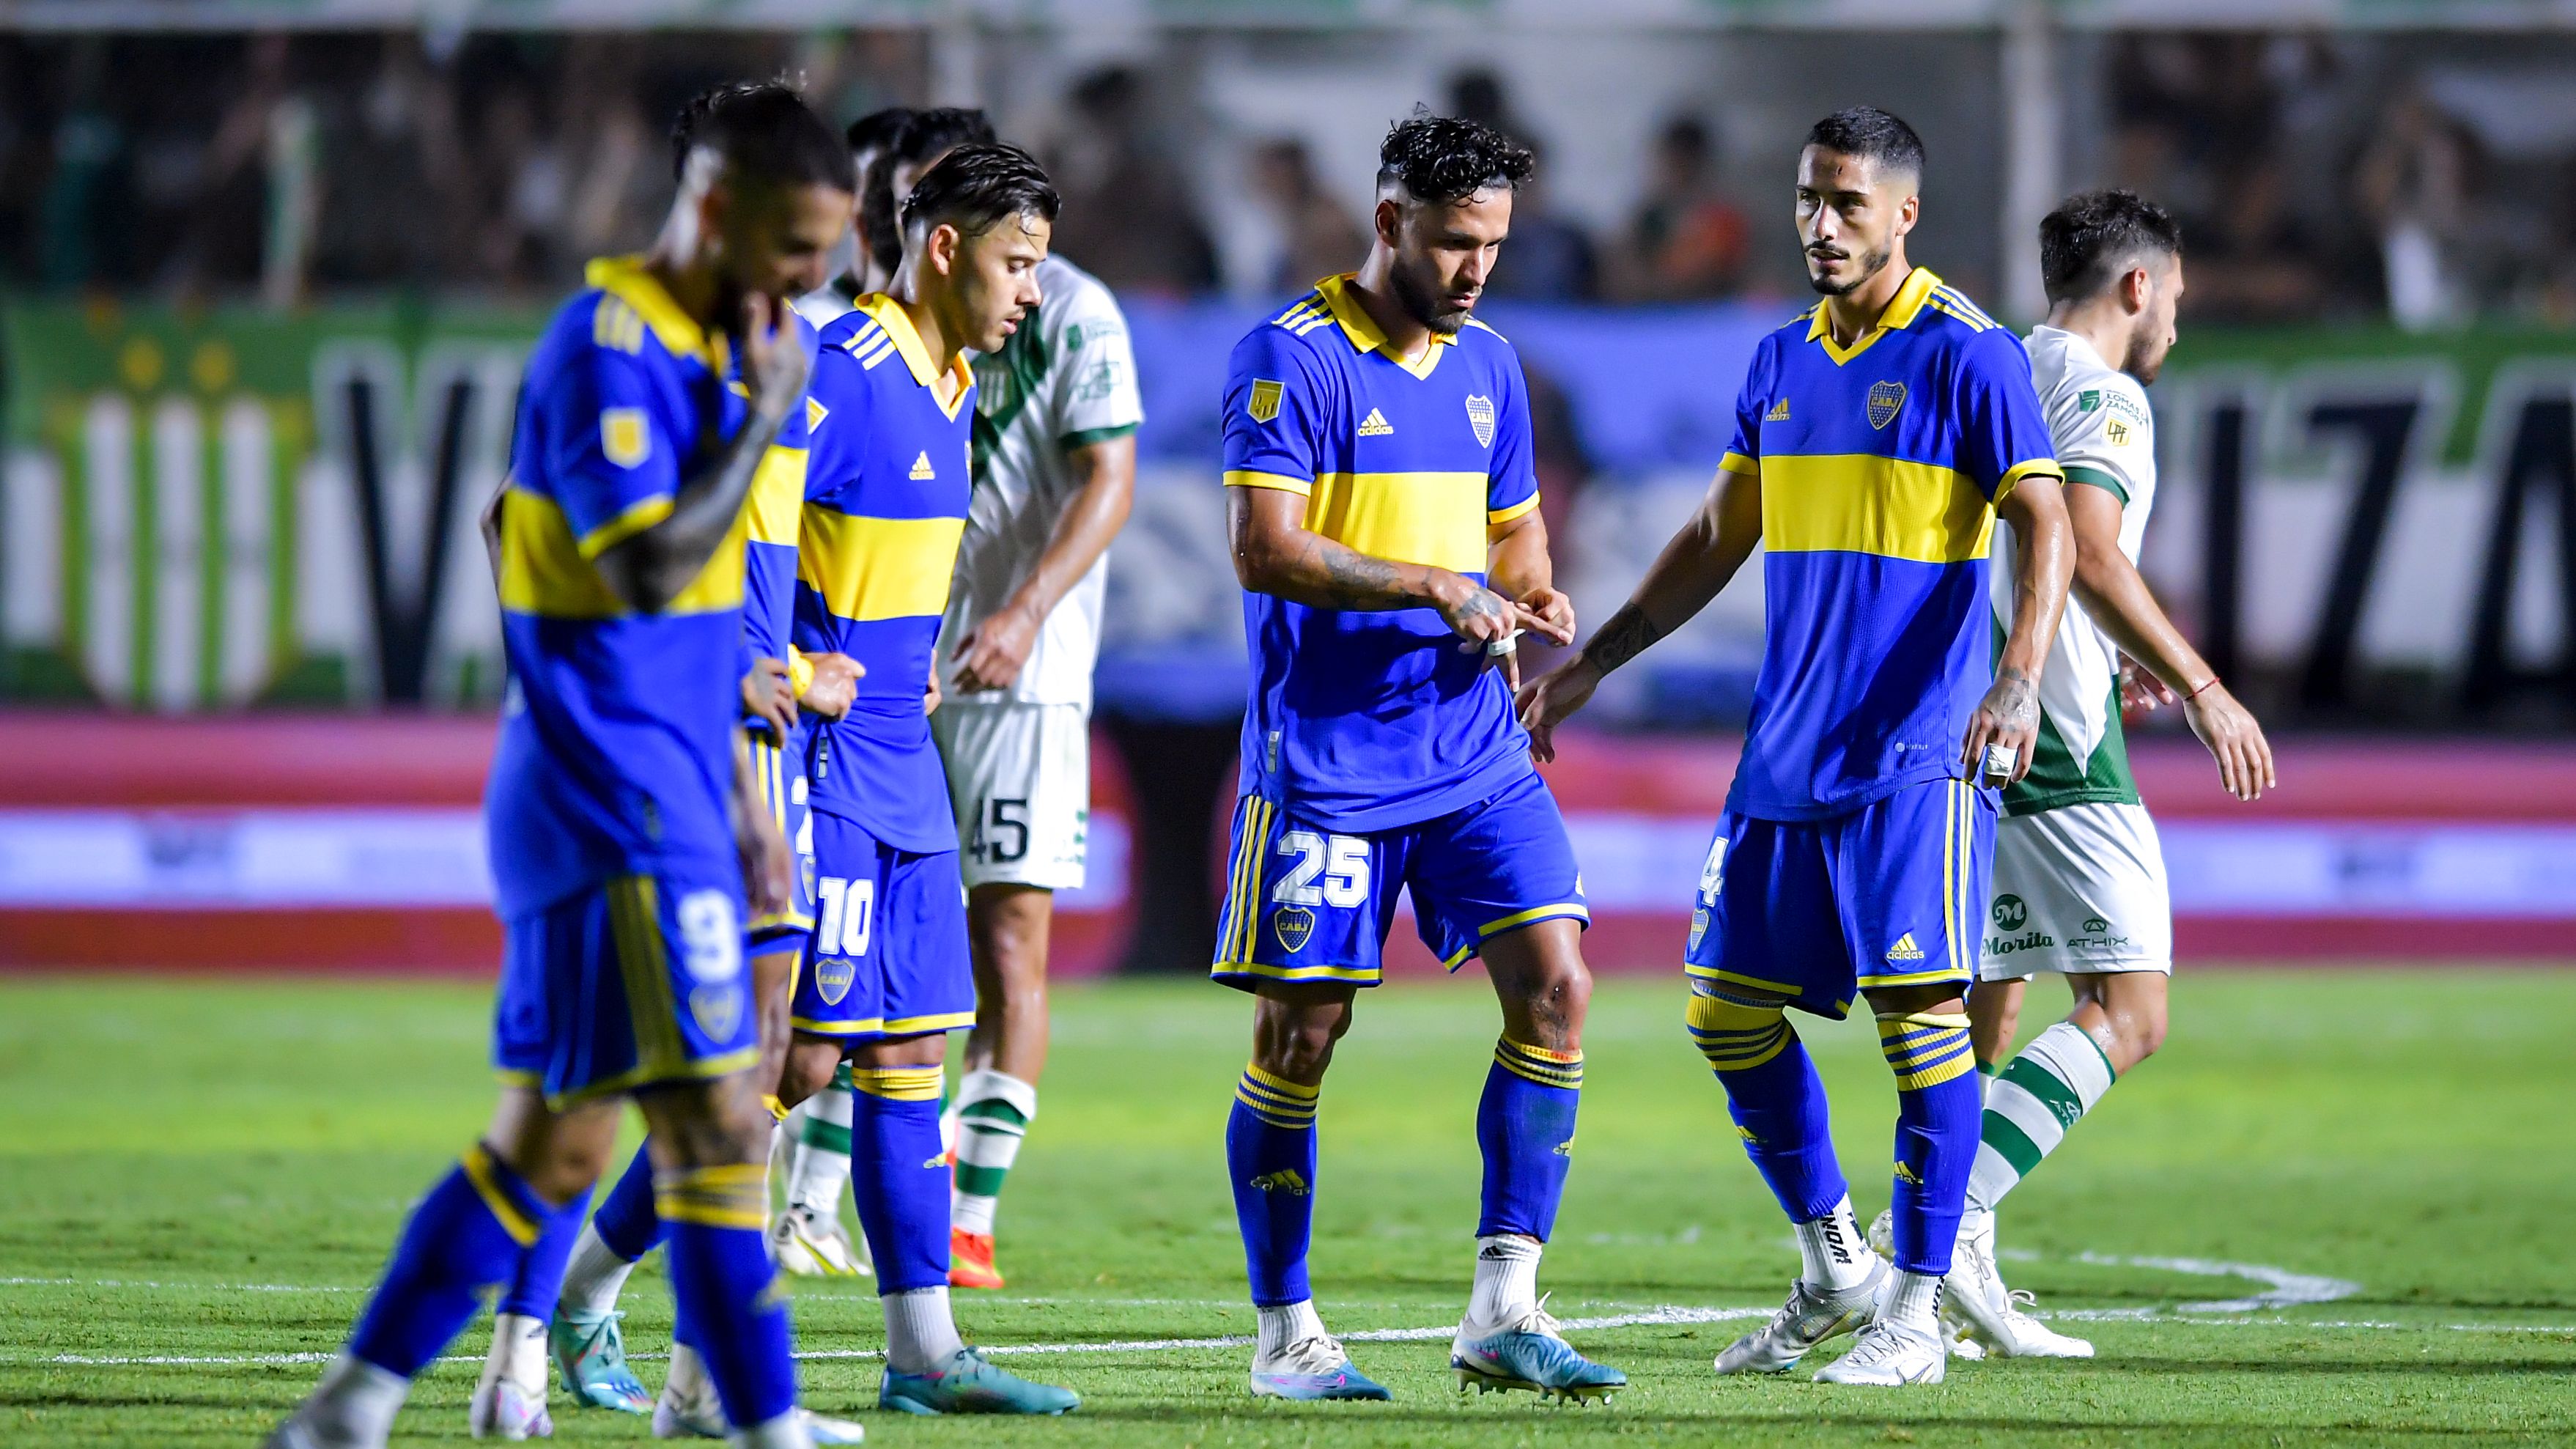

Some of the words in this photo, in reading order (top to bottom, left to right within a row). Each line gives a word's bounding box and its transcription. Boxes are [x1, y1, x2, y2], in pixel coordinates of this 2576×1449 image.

[2106, 393, 2140, 415] LOMAS
[1357, 424, 1395, 437] adidas
[968, 797, 1028, 865] 45
[1272, 830, 1370, 908] 25
[1700, 836, 1730, 907] 4
[676, 888, 742, 984] 9
[817, 877, 874, 956] 10
[1886, 950, 1925, 960] adidas
[1981, 932, 2054, 956] Morita
[2066, 937, 2128, 948] ATHIX
